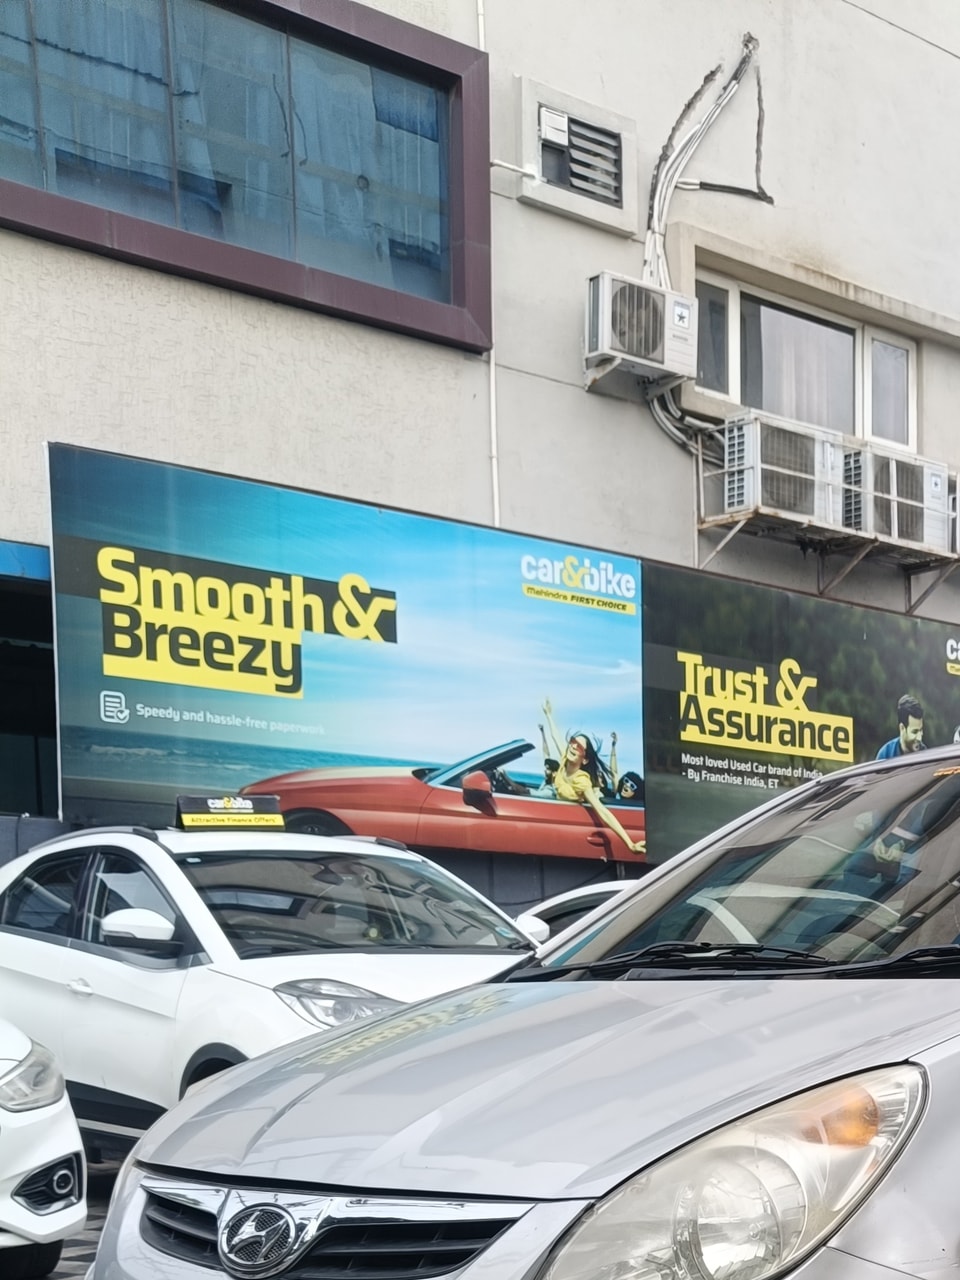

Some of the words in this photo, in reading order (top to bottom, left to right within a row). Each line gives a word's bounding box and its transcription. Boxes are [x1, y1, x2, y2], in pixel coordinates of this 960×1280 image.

[97, 547, 325, 634] Smooth
[332, 573, 397, 641] &
[521, 554, 636, 598] car&bike
[571, 595, 595, 606] FIRST
[597, 599, 627, 612] CHOICE
[102, 602, 303, 693] Breezy
[677, 651, 769, 705] Trust
[776, 658, 818, 711] &
[136, 703, 180, 722] Speedy
[182, 710, 204, 723] and
[206, 712, 267, 730] hassle-free
[270, 720, 326, 736] paperwork
[680, 693, 850, 755] Assurance
[681, 753, 703, 766] Most
[705, 756, 729, 769] loved
[730, 759, 752, 772] Used
[753, 762, 766, 774] Car
[768, 764, 792, 777] brand
[793, 767, 802, 777] of
[803, 769, 823, 780] India
[688, 769, 700, 782] By
[702, 770, 743, 785] Franchise
[744, 776, 767, 789] India,
[768, 779, 779, 789] ET
